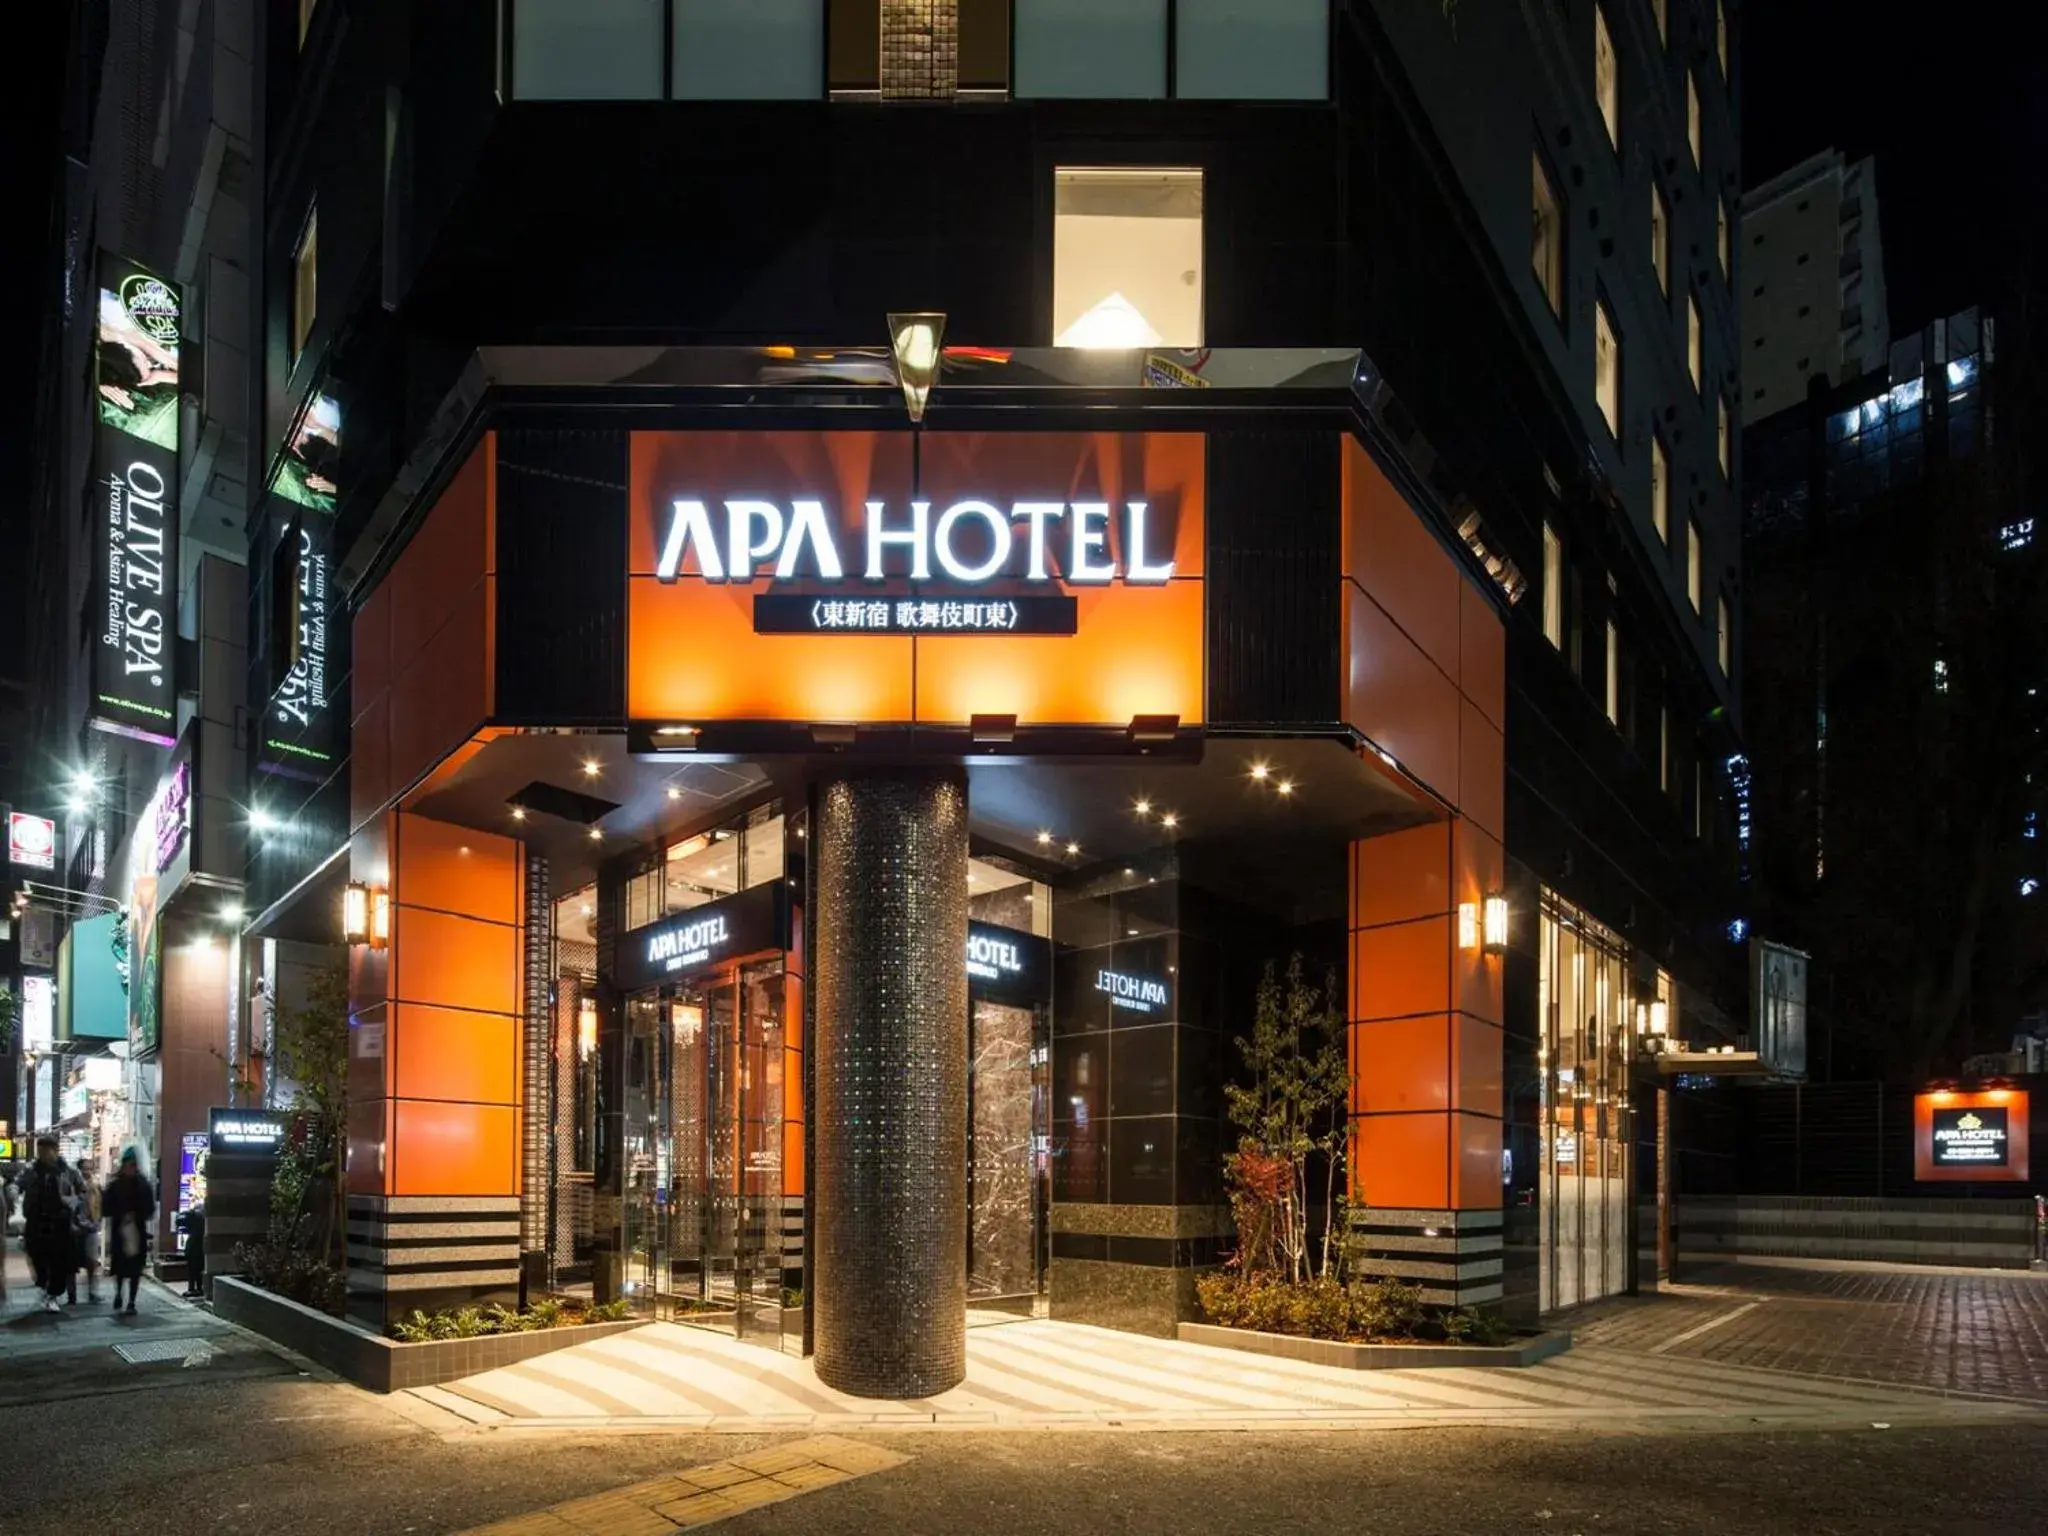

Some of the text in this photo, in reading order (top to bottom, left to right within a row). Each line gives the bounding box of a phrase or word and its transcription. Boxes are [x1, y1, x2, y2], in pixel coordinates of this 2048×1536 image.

[102, 472, 126, 648] Aroma & Asian Healing
[126, 461, 164, 596] OLIVE
[655, 499, 1177, 581] APA HOTEL
[648, 931, 678, 962] APA
[677, 915, 729, 954] HOTEL
[243, 1122, 285, 1136] HOTEL
[1961, 1128, 2006, 1140] HOTEL
